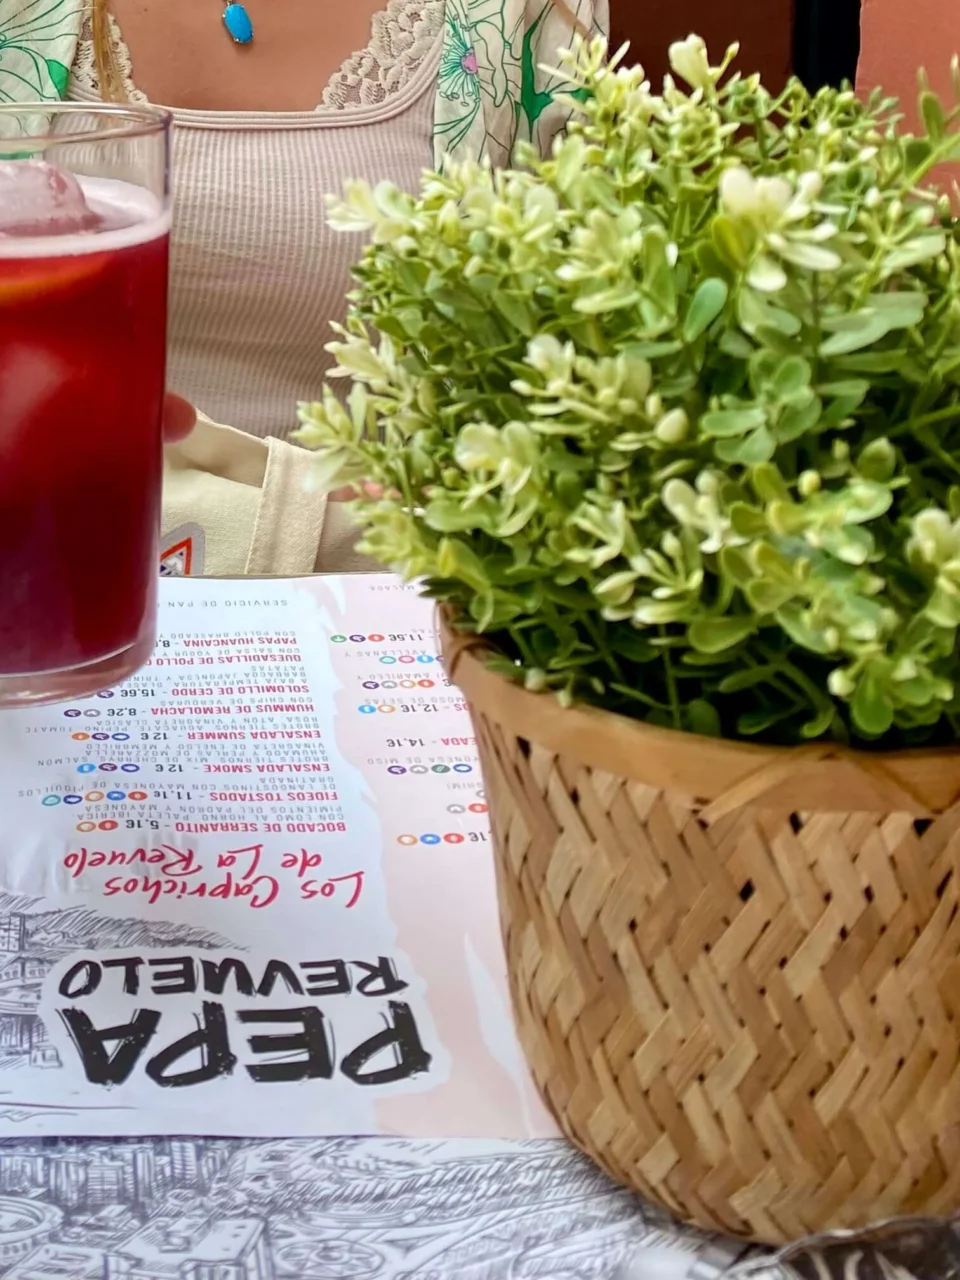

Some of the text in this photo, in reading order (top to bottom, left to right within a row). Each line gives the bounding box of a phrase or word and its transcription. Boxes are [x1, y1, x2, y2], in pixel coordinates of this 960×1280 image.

[168, 600, 193, 608] PAN
[224, 599, 288, 607] SERVICIO
[183, 638, 254, 648] HUANCAINA
[258, 637, 297, 645] PAPAS
[156, 657, 194, 666] POLLO
[199, 657, 213, 665] DE
[218, 654, 301, 664] QUESADILLAS
[172, 688, 213, 696] CERDO
[218, 687, 233, 695] DE
[238, 685, 309, 694] SOLOMILLO
[150, 706, 231, 716] REMOLACHA
[235, 705, 251, 713] DE
[256, 704, 314, 712] HUMMUS
[153, 732, 168, 740] 12
[187, 731, 246, 740] SUMMER
[250, 730, 321, 739] ENSALADA
[367, 757, 398, 765] MISO
[168, 764, 183, 772] 12
[203, 764, 253, 773] SMOKE
[257, 764, 330, 772] ENSALADA
[114, 781, 185, 790] MAYONESA
[223, 783, 313, 791] LANGOSTINOS
[17, 784, 84, 797] PIQUILLOS
[209, 792, 284, 802] TOSTADOS
[287, 791, 338, 800] FIDEOS
[84, 803, 157, 812] MAYONESA
[240, 806, 263, 814] DEL
[137, 811, 189, 821] PALETA
[176, 822, 257, 833] SERRANITO
[263, 823, 281, 832] DE
[286, 822, 346, 832] BOCADO
[63, 844, 322, 879] de La Revuelo
[103, 871, 364, 908] Los Caprichos
[58, 956, 409, 999] REVUELO
[55, 1001, 432, 1089] PEPA
